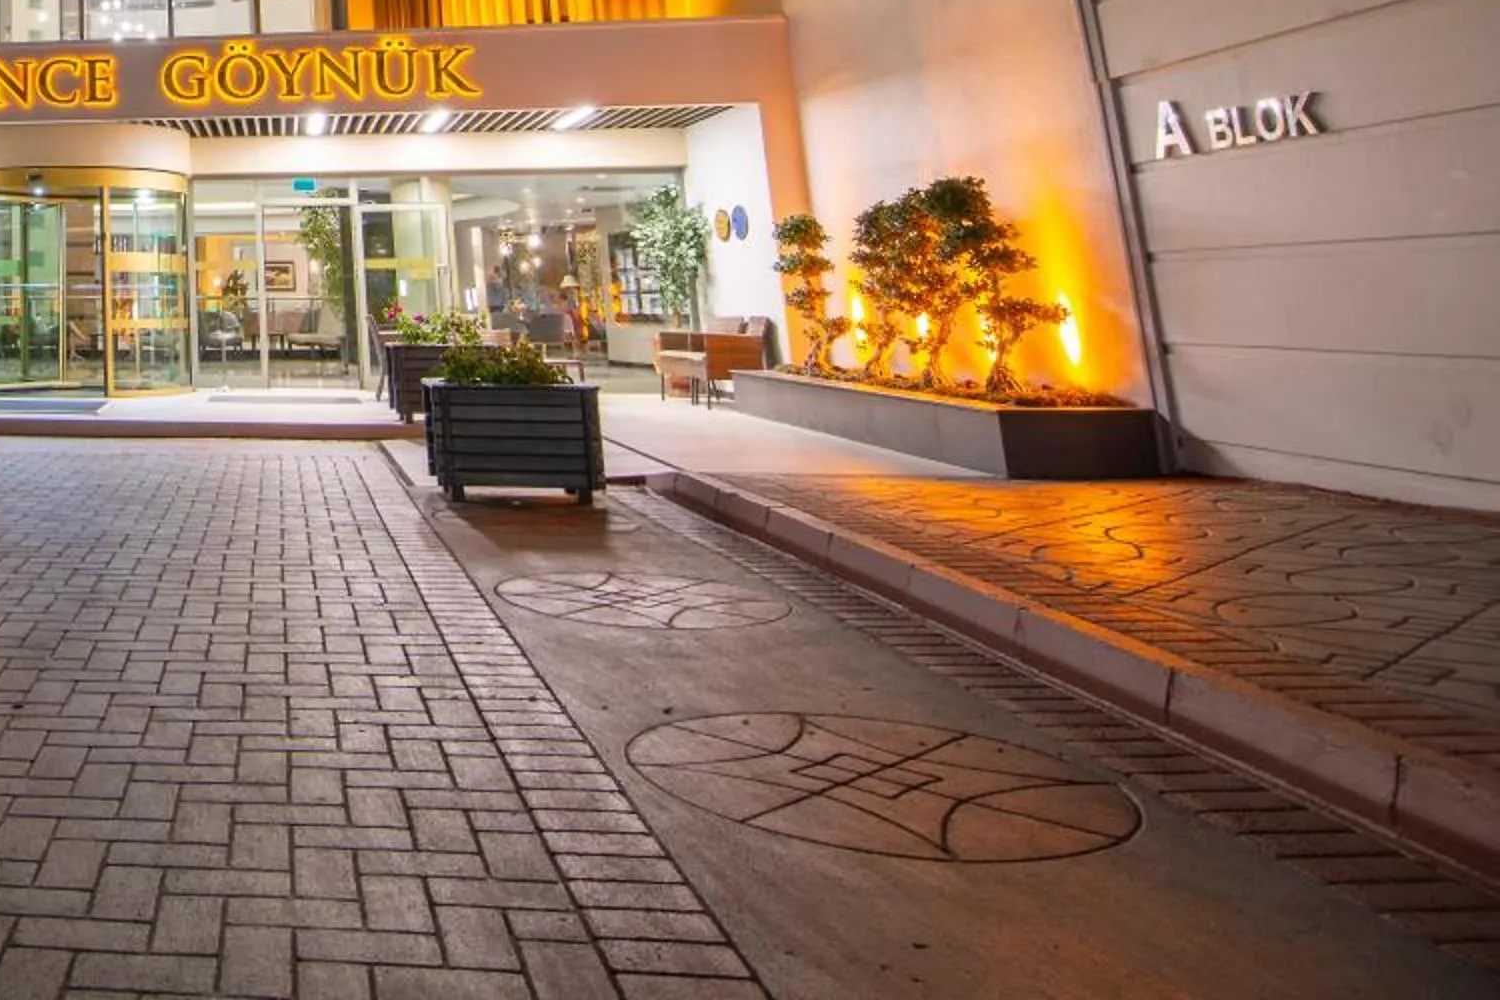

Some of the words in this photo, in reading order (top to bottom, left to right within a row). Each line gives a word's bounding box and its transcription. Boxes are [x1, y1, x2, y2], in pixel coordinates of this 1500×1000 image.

[162, 38, 481, 101] GÖYNÜK
[1155, 99, 1197, 160] A
[1205, 90, 1322, 150] BLOK
